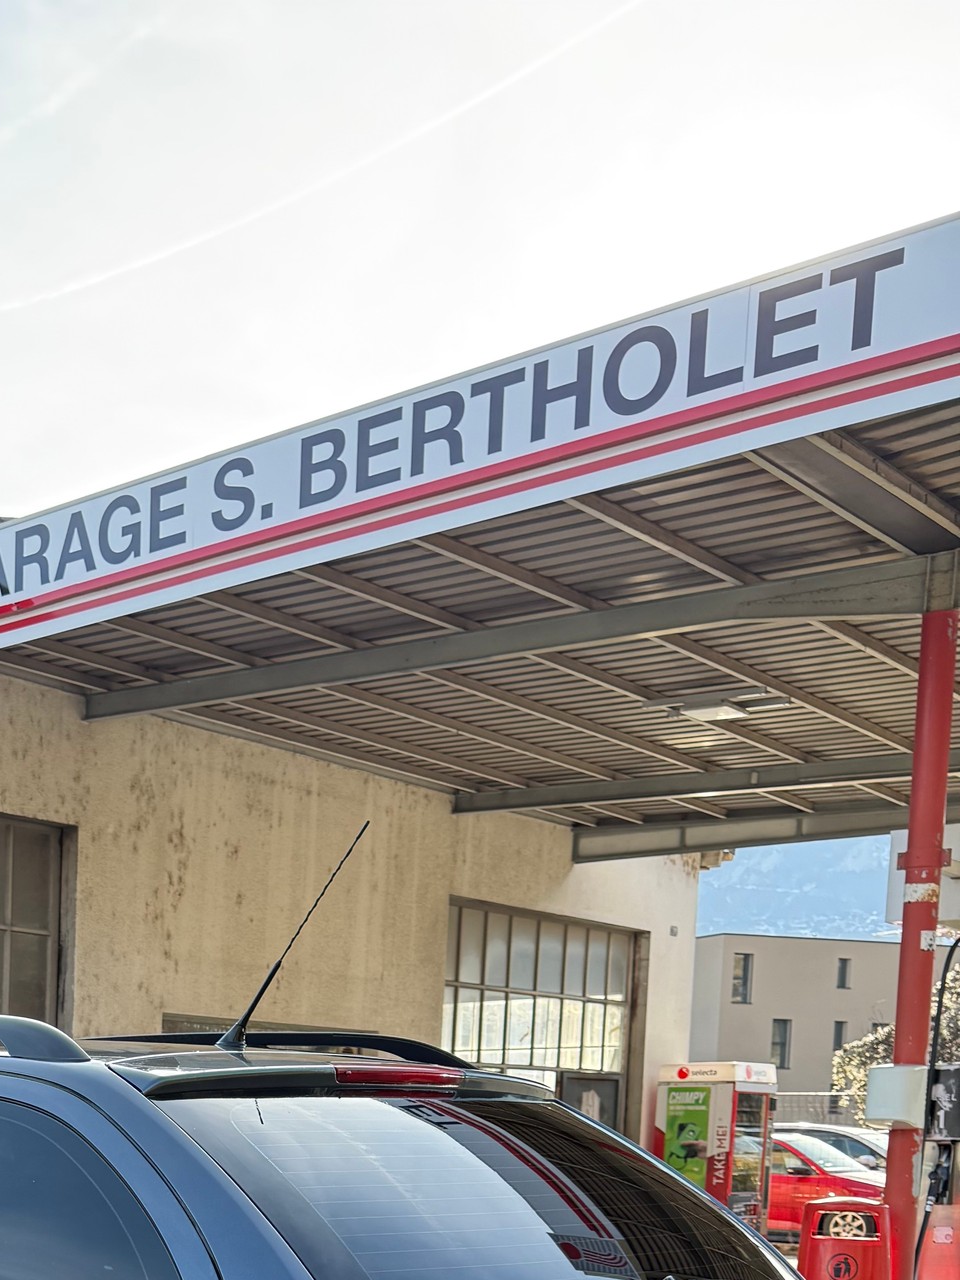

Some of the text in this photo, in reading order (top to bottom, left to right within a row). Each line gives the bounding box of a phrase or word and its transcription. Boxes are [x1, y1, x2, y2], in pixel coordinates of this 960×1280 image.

[210, 456, 274, 533] S.
[299, 247, 906, 505] BERTHOLET
[669, 1091, 707, 1104] CHIMPY
[712, 1152, 727, 1186] TAKE
